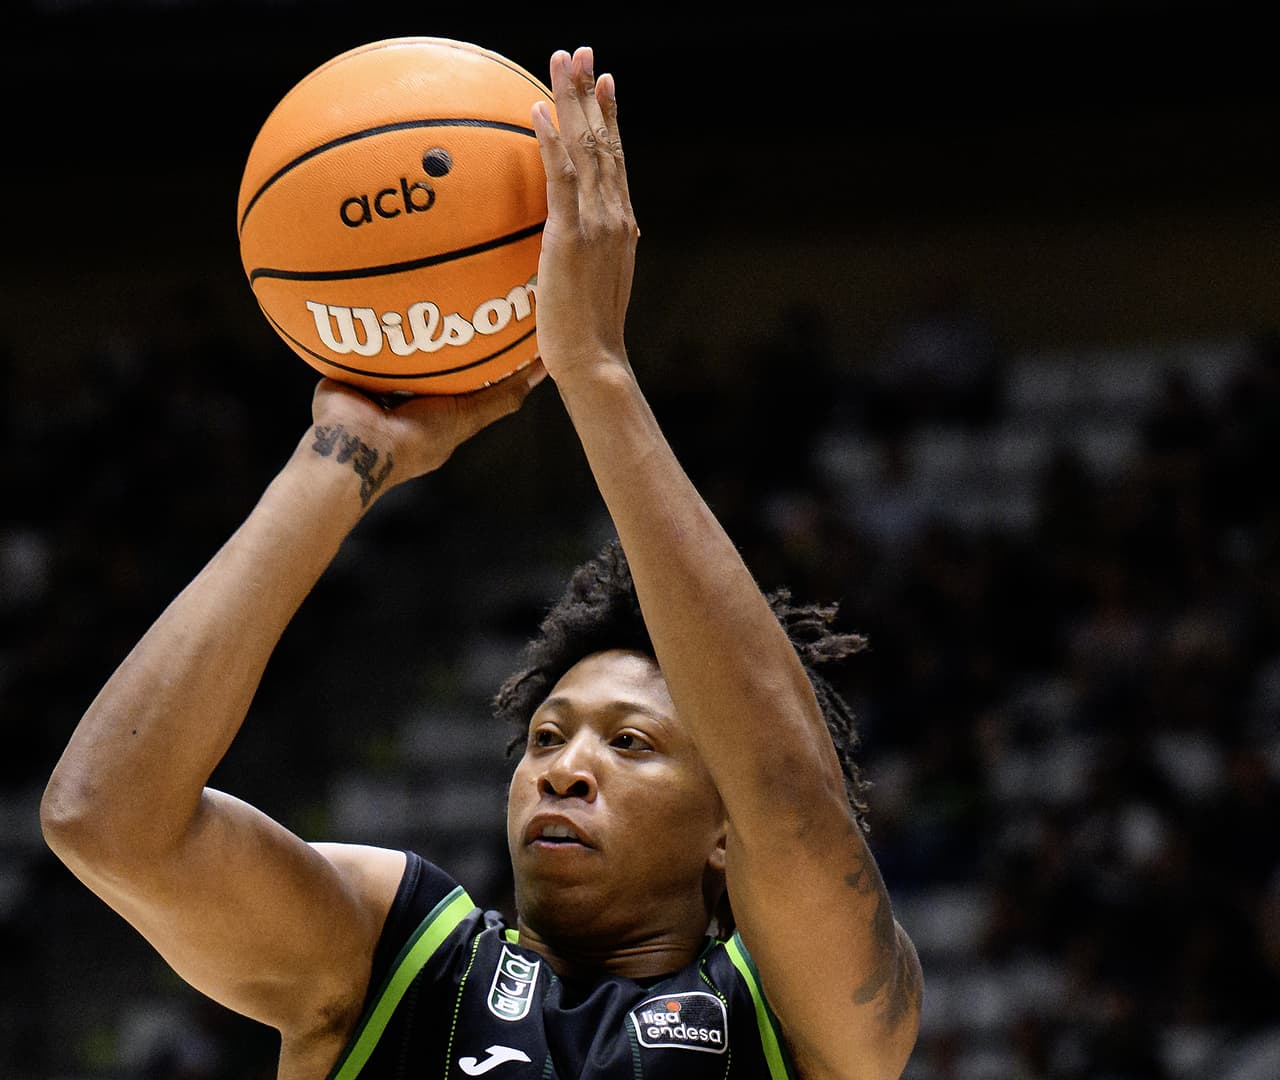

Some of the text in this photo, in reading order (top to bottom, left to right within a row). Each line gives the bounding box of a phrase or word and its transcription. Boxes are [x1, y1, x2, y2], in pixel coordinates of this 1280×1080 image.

[339, 178, 437, 228] acb
[306, 283, 537, 357] Wilson
[641, 1008, 681, 1026] liga
[646, 1023, 722, 1043] endesa
